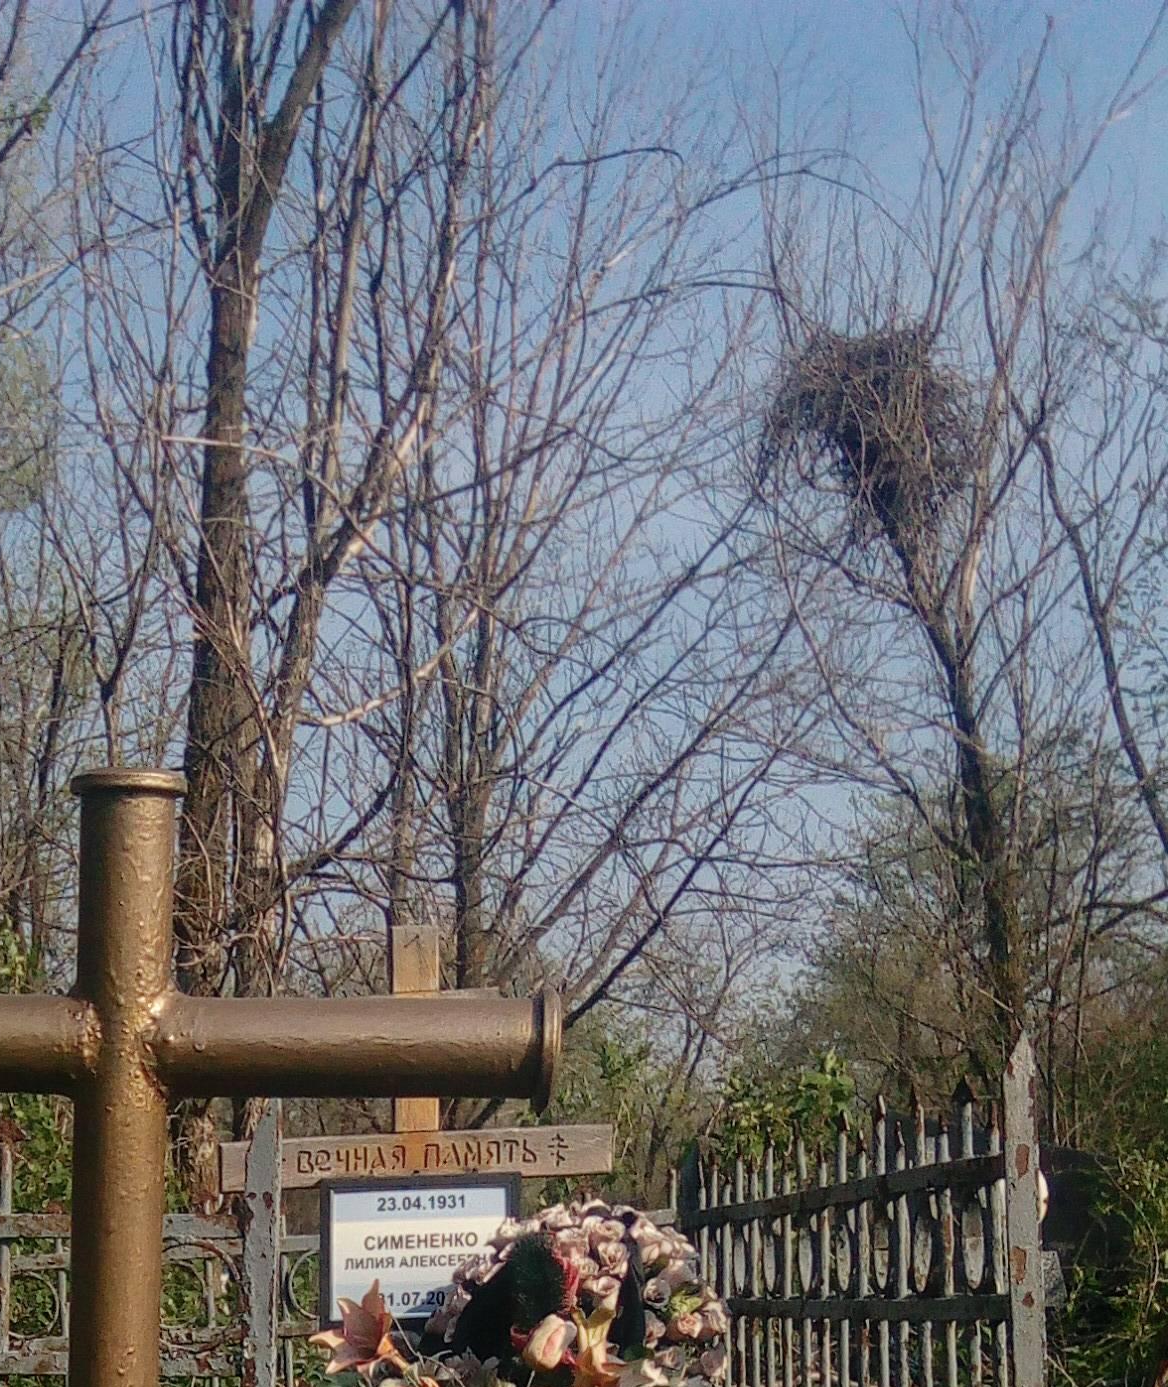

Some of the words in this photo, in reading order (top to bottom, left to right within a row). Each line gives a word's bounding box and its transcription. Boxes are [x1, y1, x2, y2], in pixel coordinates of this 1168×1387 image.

[423, 1139, 537, 1169] ПАМЯТЬ
[377, 1194, 465, 1212] 23.04.1931
[364, 1232, 478, 1250] СИМЕНЕНКО
[345, 1257, 394, 1270] ЛИЛИЯ
